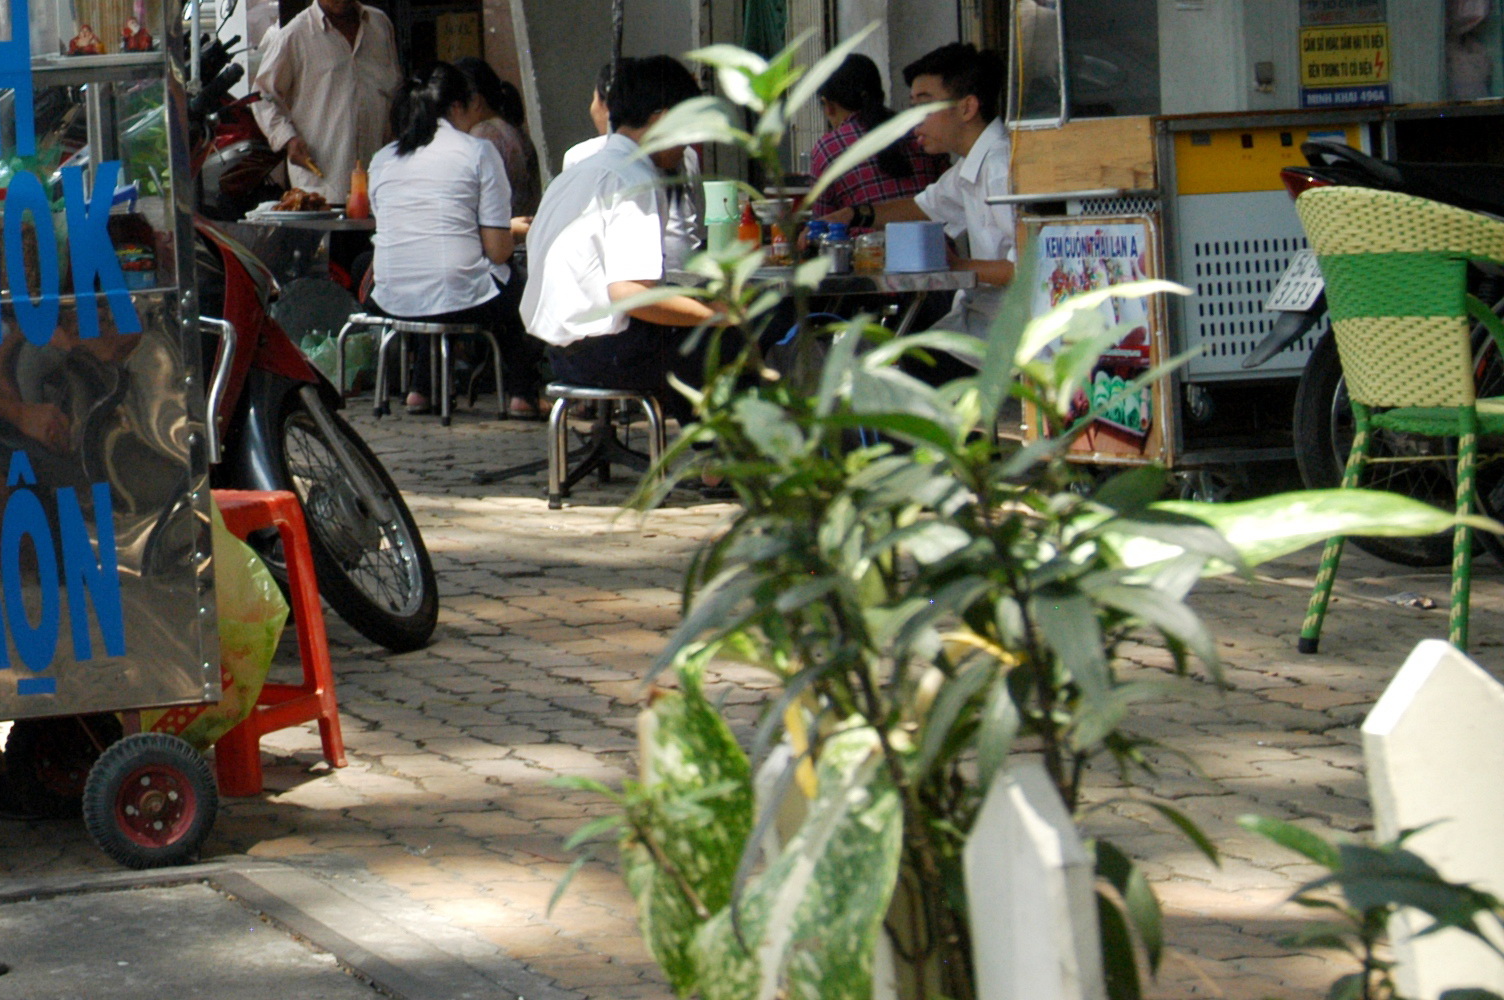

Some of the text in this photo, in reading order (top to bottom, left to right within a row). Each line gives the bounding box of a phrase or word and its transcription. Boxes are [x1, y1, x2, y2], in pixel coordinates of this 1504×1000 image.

[1306, 92, 1332, 105] MINH
[1334, 91, 1357, 103] KHAI
[1046, 236, 1062, 258] KEM
[1110, 235, 1128, 258] LAN
